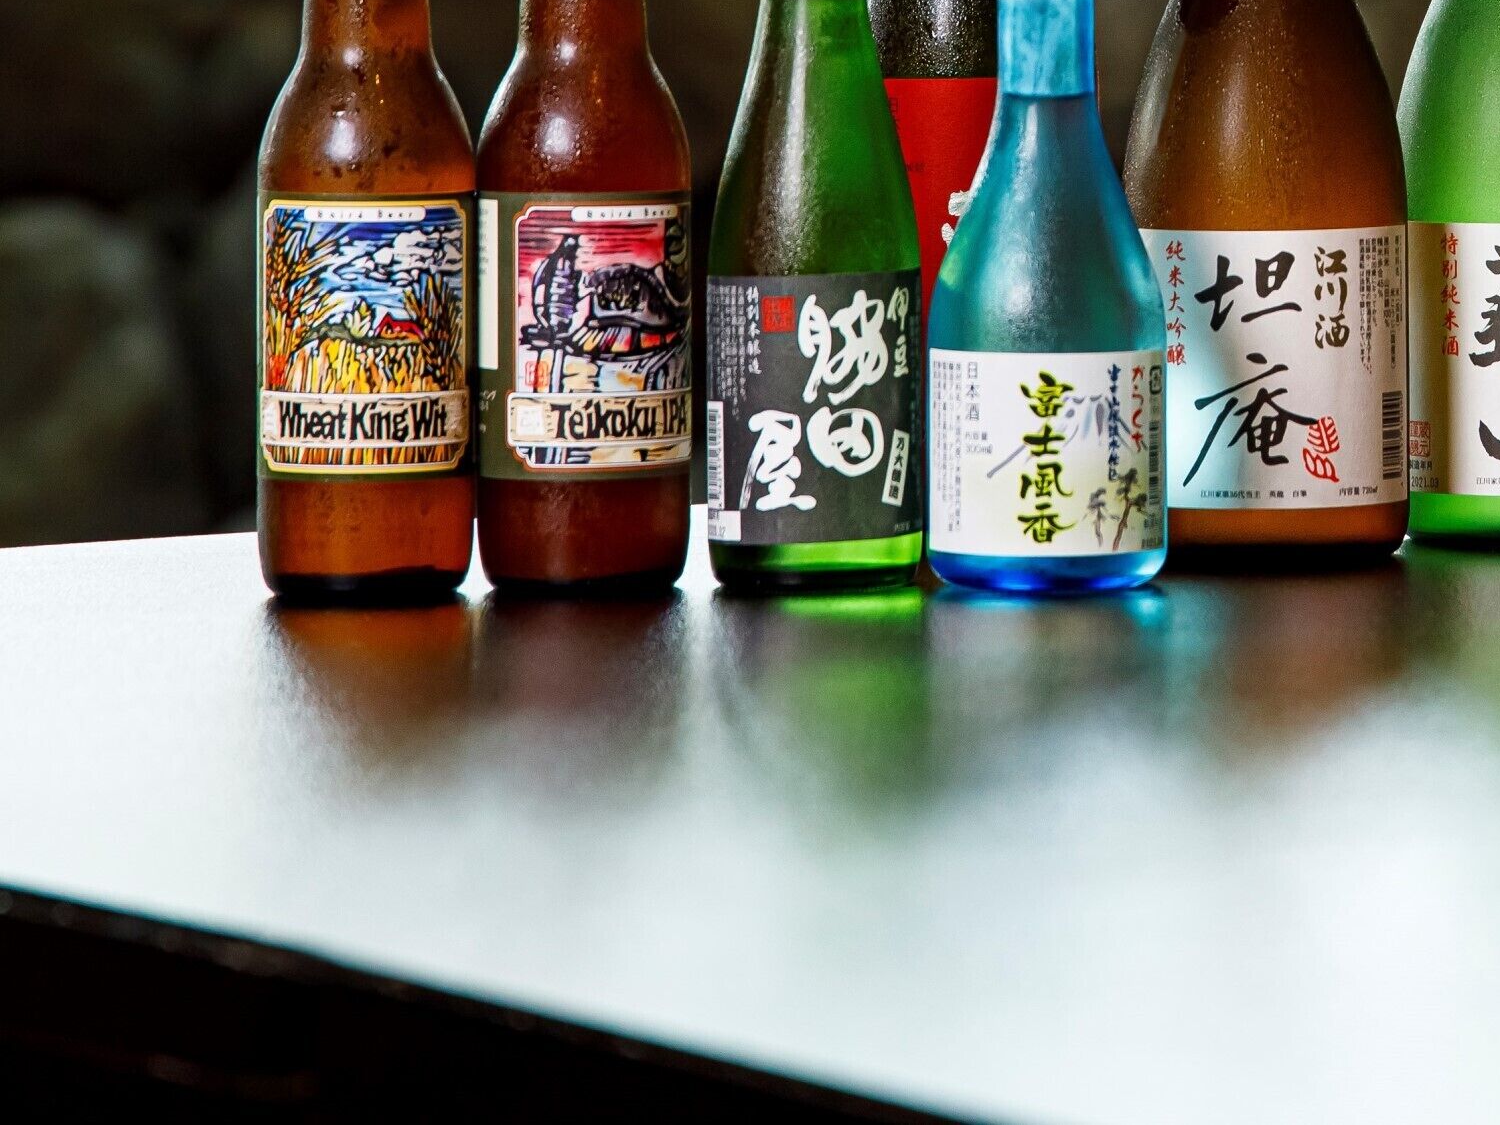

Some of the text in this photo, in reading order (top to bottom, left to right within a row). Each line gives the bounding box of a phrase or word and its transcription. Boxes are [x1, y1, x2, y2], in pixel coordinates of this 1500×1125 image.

[1166, 239, 1188, 366] 純米大吟醸
[1314, 245, 1350, 349] 江川酒
[1440, 233, 1460, 357] 特別純米酒
[279, 400, 347, 440] Wheat
[350, 400, 409, 443] King
[407, 396, 448, 439] Wit
[550, 398, 660, 440] Teikoku
[662, 394, 688, 436] IPA
[965, 362, 980, 421] 日本酒
[1339, 488, 1360, 497] 内容量
